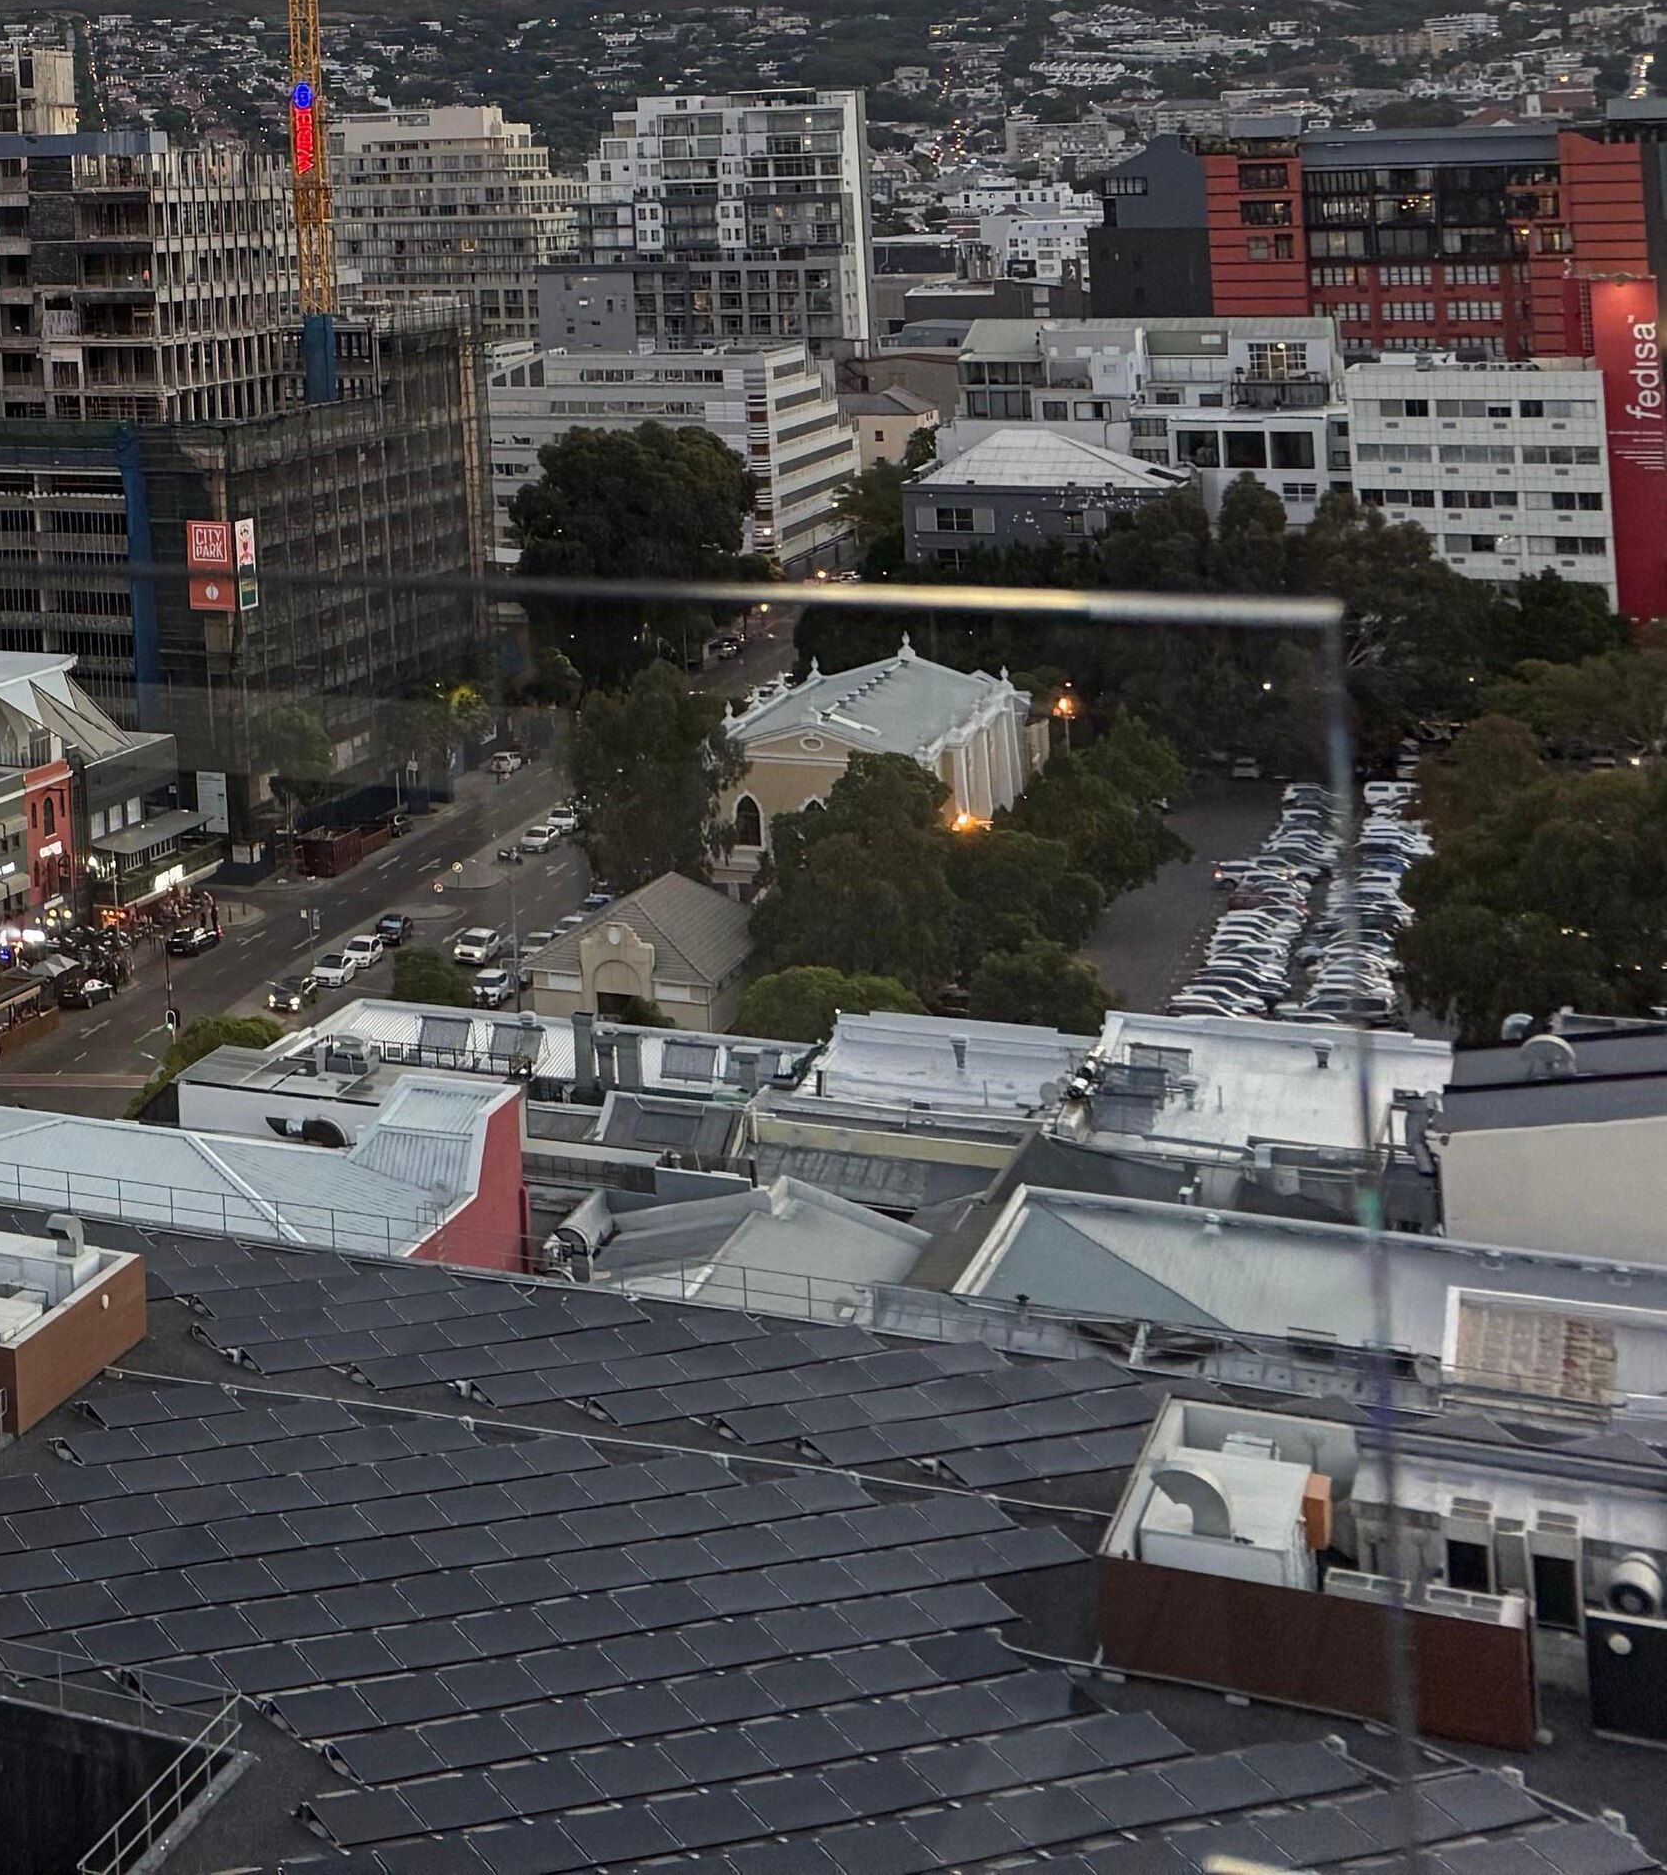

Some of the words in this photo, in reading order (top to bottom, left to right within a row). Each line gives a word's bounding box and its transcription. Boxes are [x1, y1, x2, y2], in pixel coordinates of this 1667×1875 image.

[1625, 321, 1662, 419] fedisa
[195, 528, 222, 545] CITY
[195, 541, 224, 558] PARK
